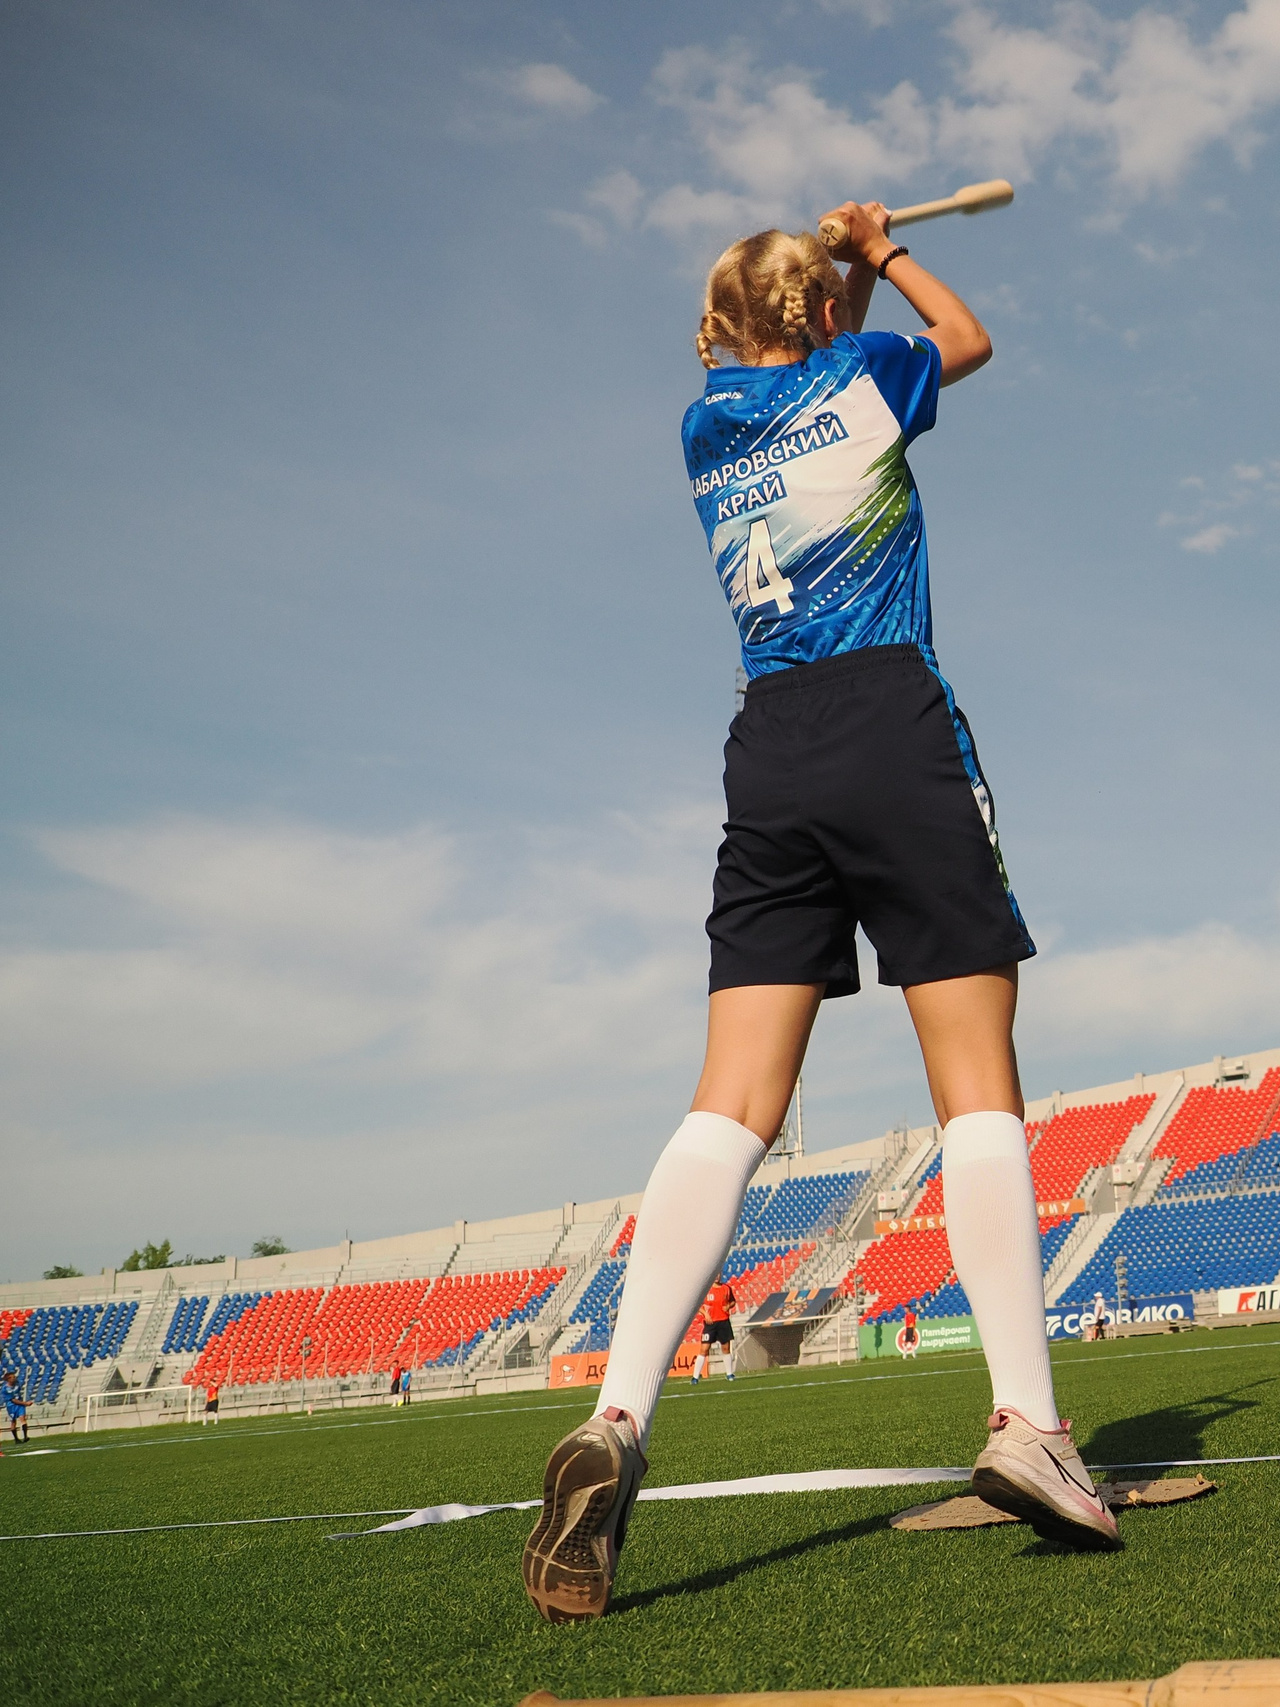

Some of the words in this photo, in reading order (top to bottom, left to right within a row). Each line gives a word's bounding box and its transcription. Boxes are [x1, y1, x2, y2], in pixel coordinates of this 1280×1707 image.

[717, 473, 785, 520] КРАЙ
[747, 518, 795, 615] 4
[888, 1215, 946, 1231] ФУТБО
